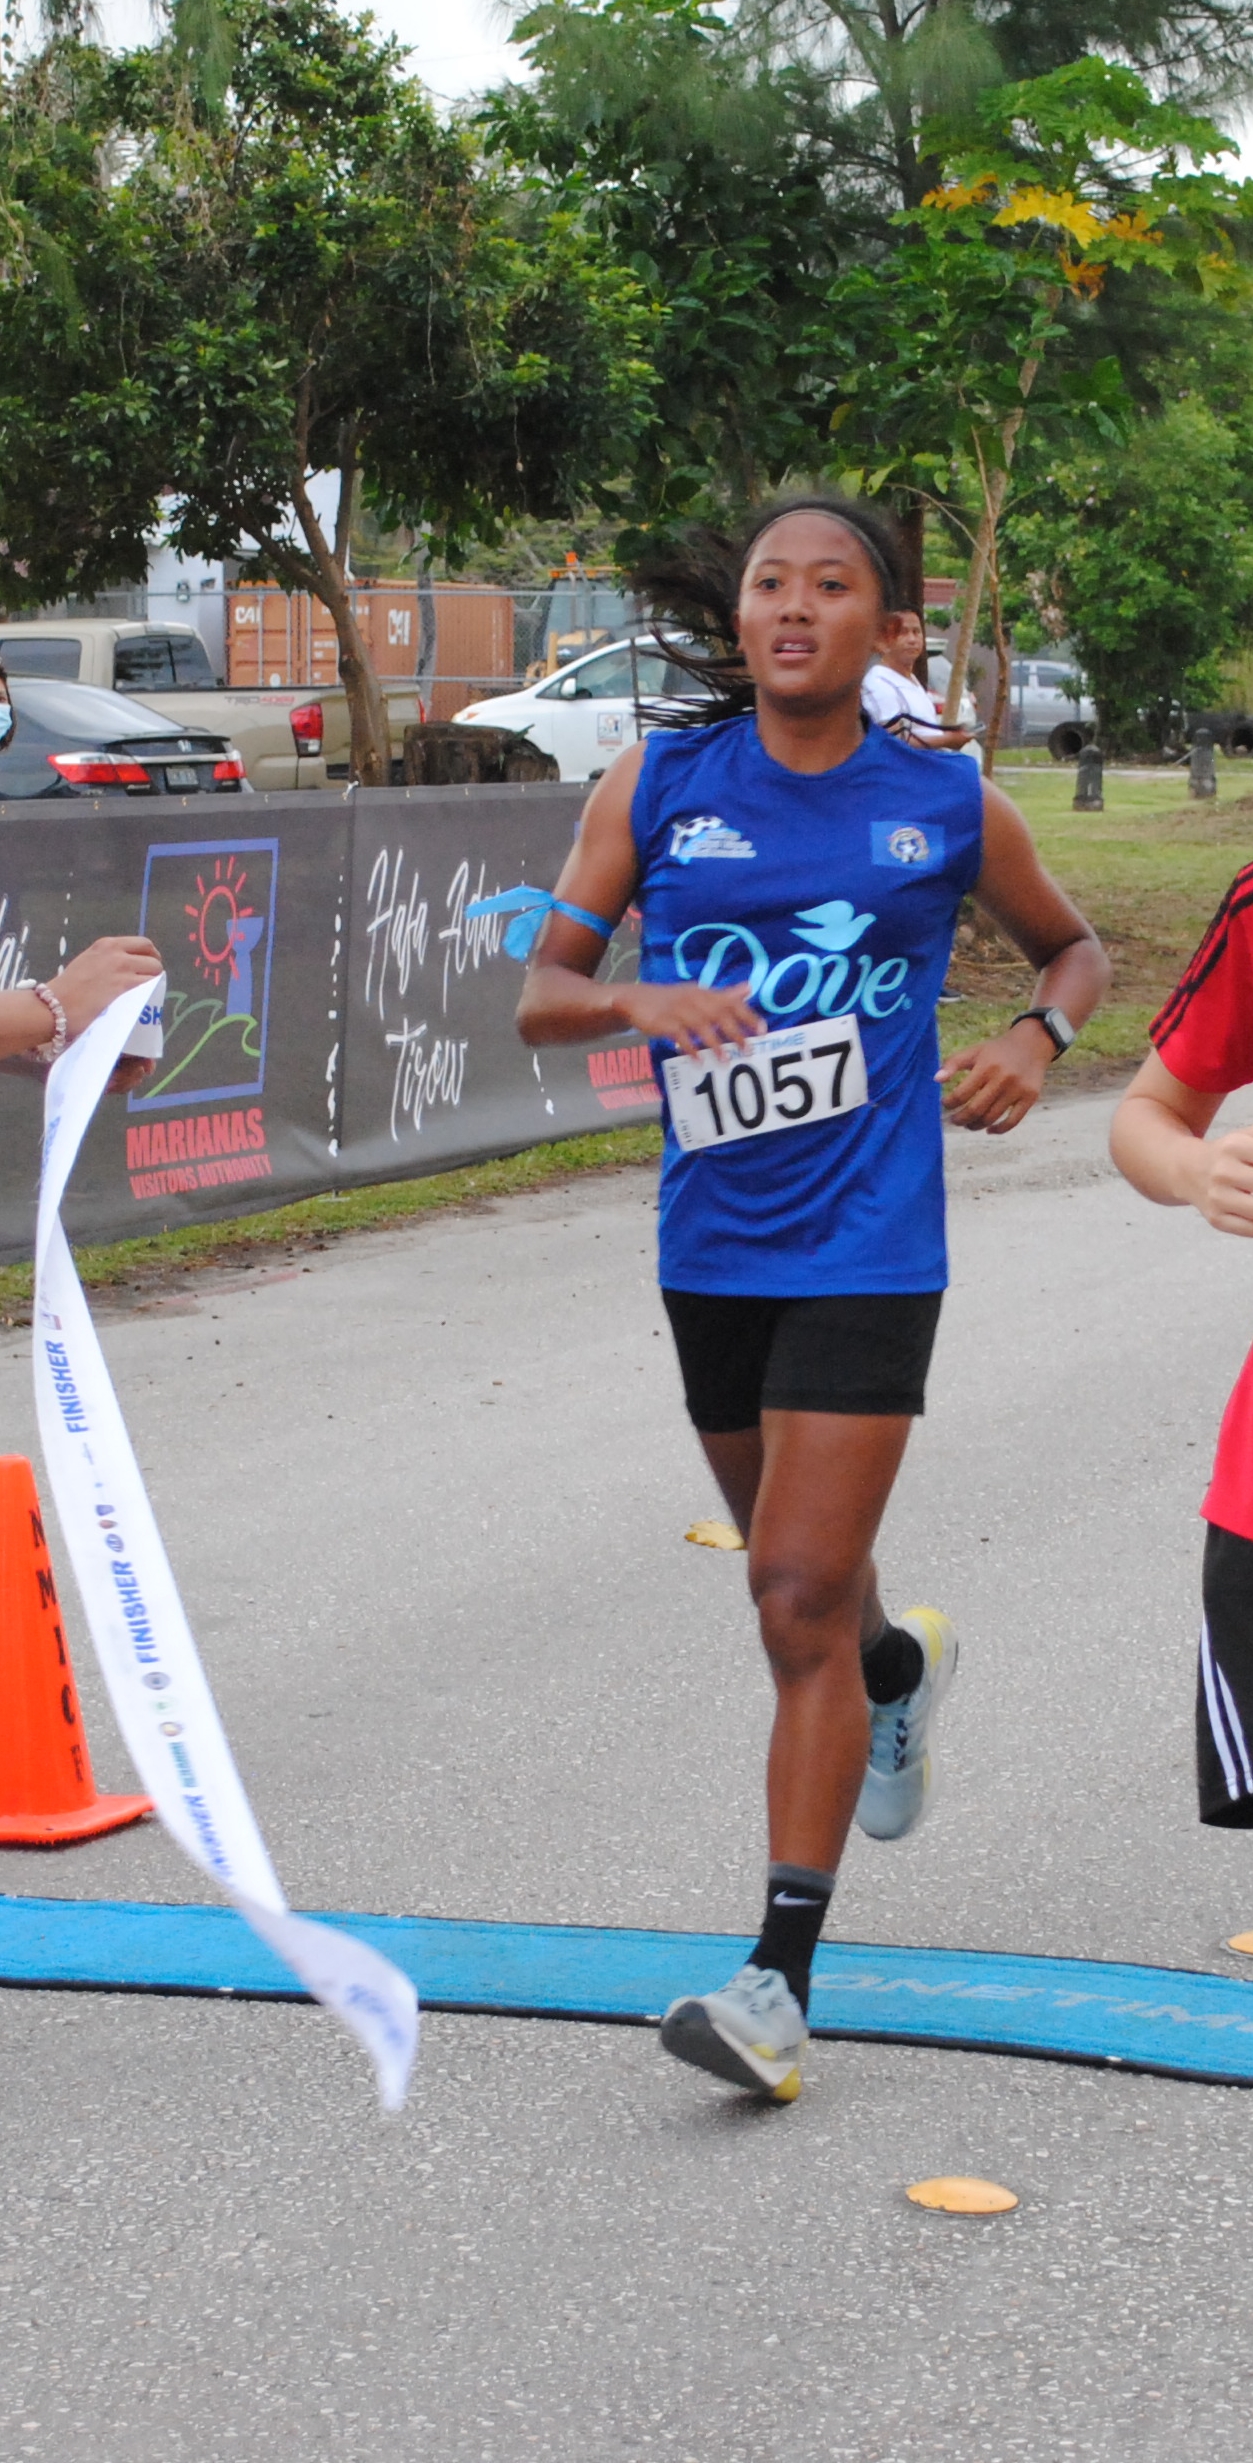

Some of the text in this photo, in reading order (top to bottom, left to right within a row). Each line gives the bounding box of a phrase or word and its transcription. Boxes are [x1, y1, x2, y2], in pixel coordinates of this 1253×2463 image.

[672, 922, 909, 1018] Dove
[695, 1039, 852, 1136] 1057
[126, 1107, 266, 1170] MARIANAS
[130, 1153, 272, 1200] VISITORS AUTHORITY
[45, 1340, 90, 1434] FINISHER
[111, 1559, 161, 1664] FINISHER
